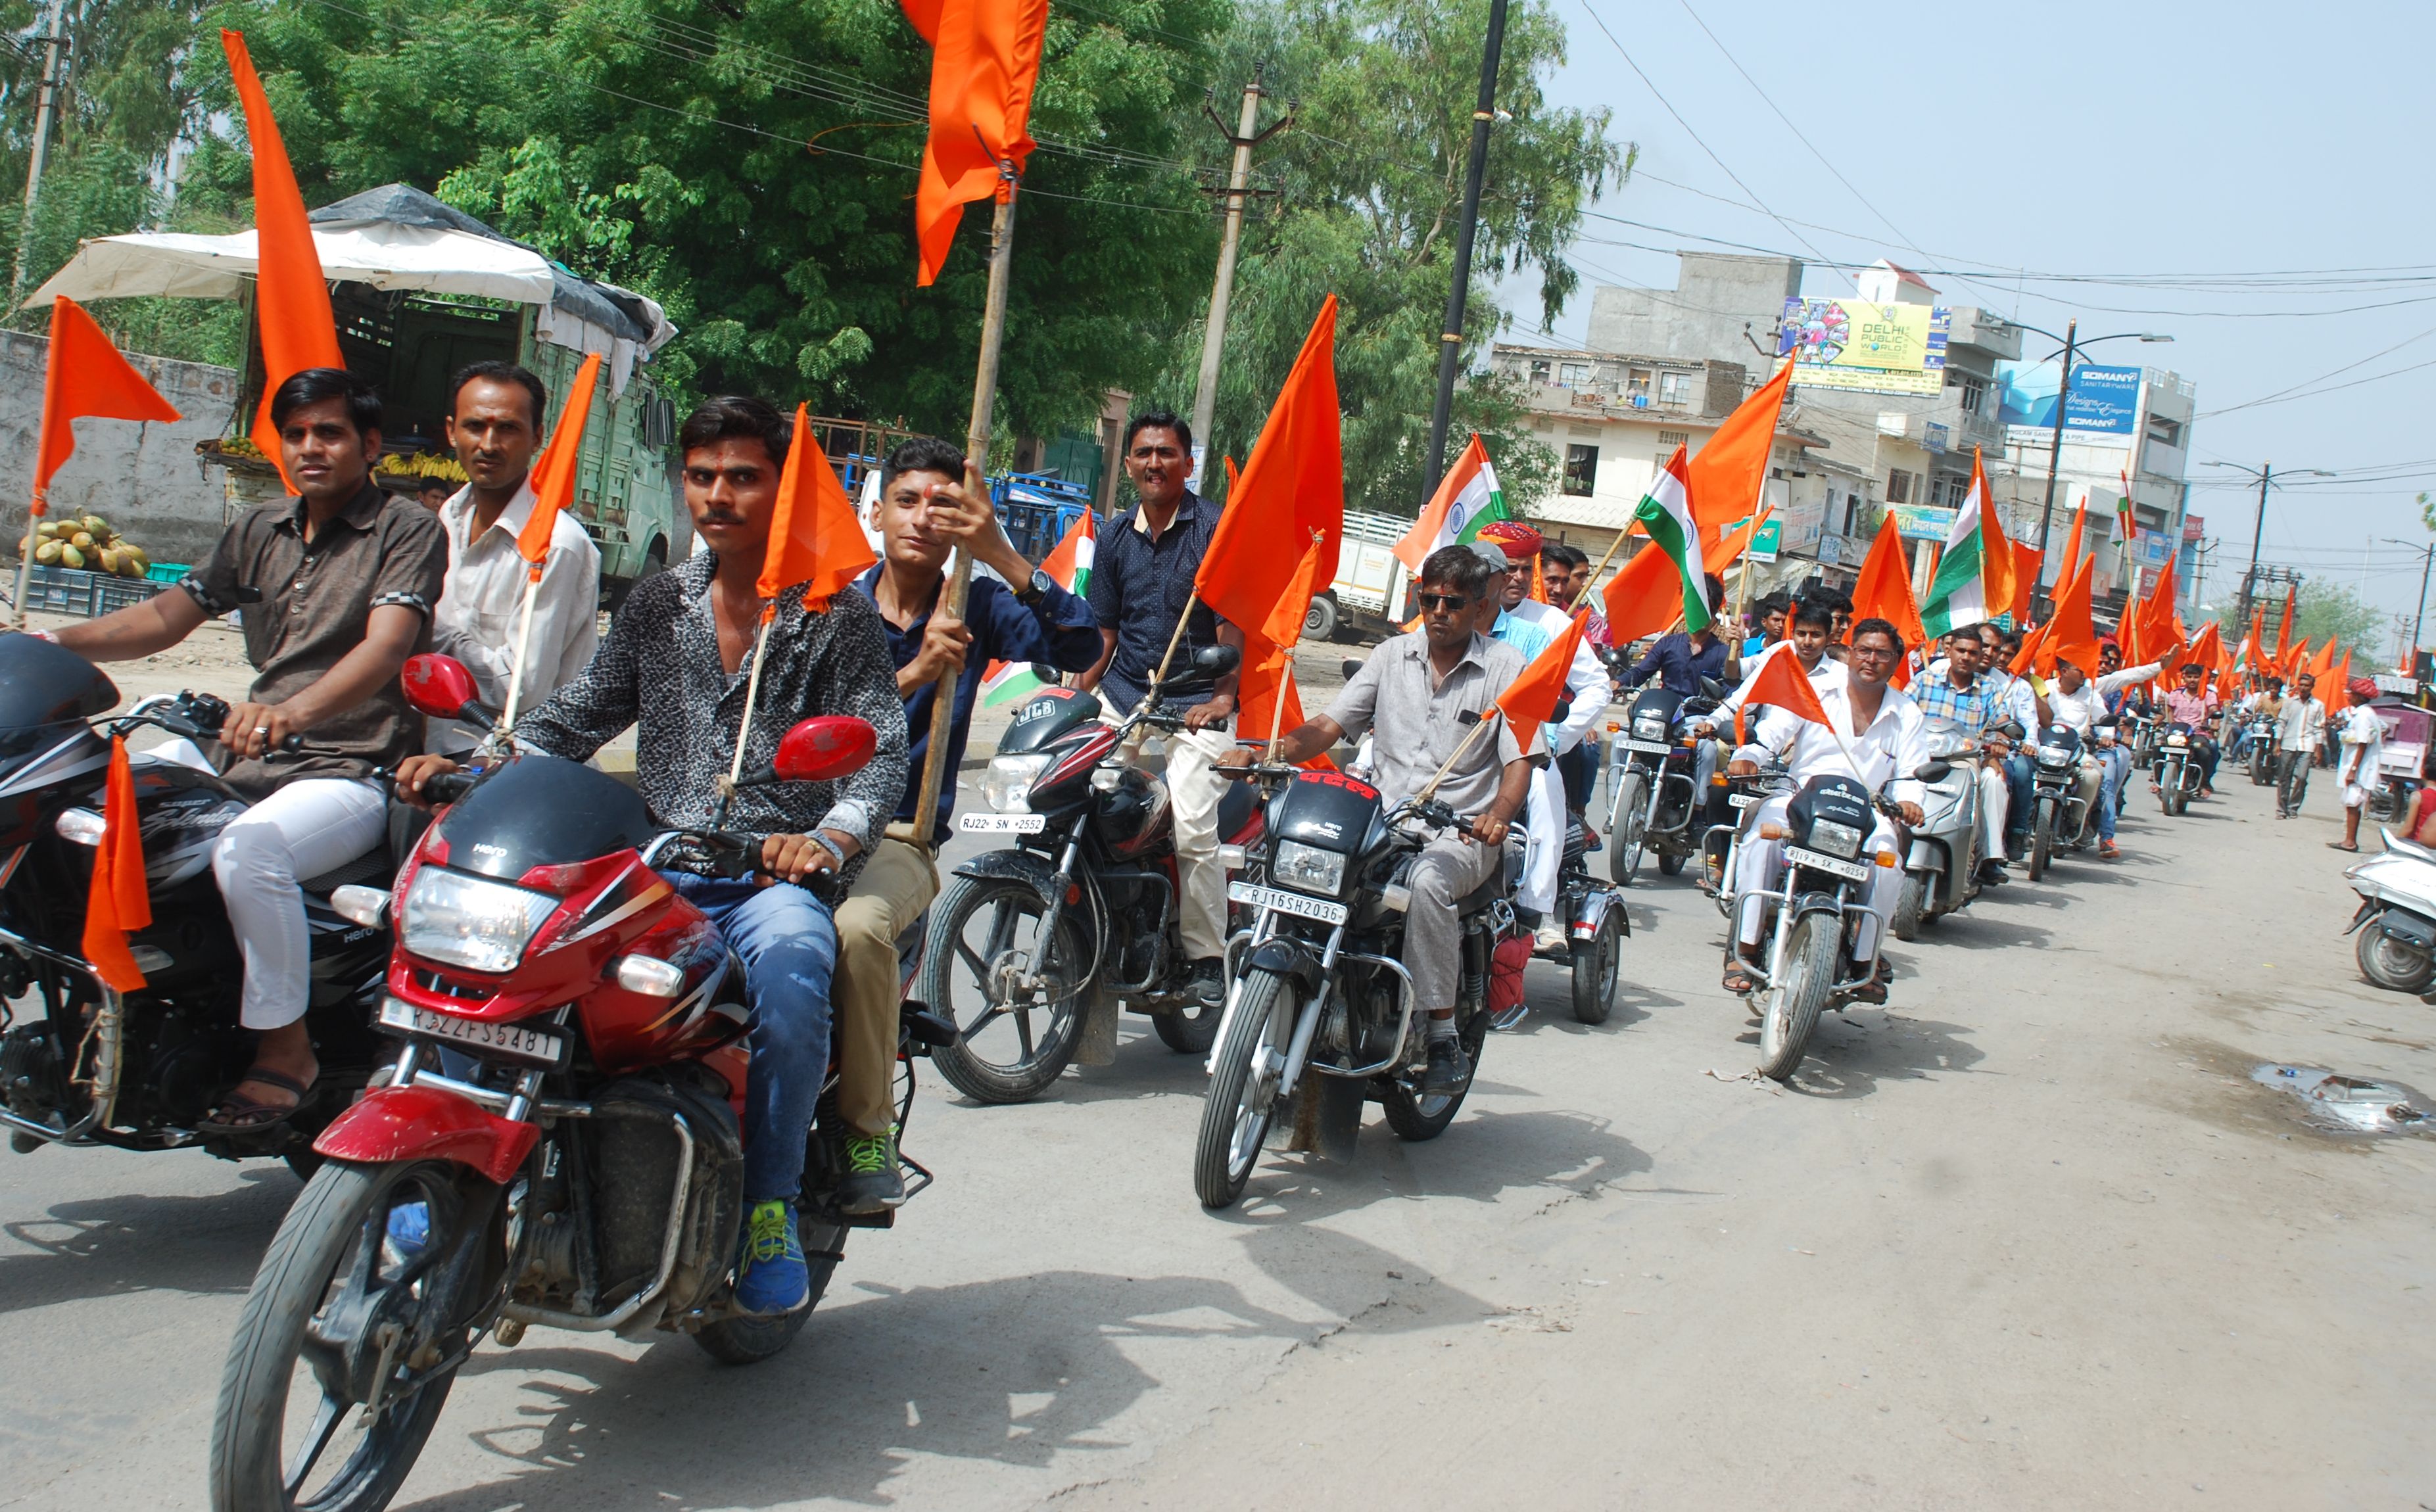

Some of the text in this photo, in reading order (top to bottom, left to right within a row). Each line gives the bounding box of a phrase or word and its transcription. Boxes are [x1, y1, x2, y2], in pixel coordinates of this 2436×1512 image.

[1863, 323, 1904, 335] DELHI
[1861, 334, 1903, 344] PUBLIC
[2081, 371, 2136, 382] SOMANY
[2080, 380, 2136, 390] SANITARYWARE
[2067, 417, 2115, 427] SOMANY
[1019, 701, 1052, 723] JCB
[963, 818, 1041, 830] RJ22 SN 2552
[473, 843, 508, 858] Hero
[1790, 850, 1809, 861] RJ19
[1846, 866, 1865, 878] 0254
[1251, 889, 1338, 920] RJ16SH2036
[344, 927, 374, 943] Hero
